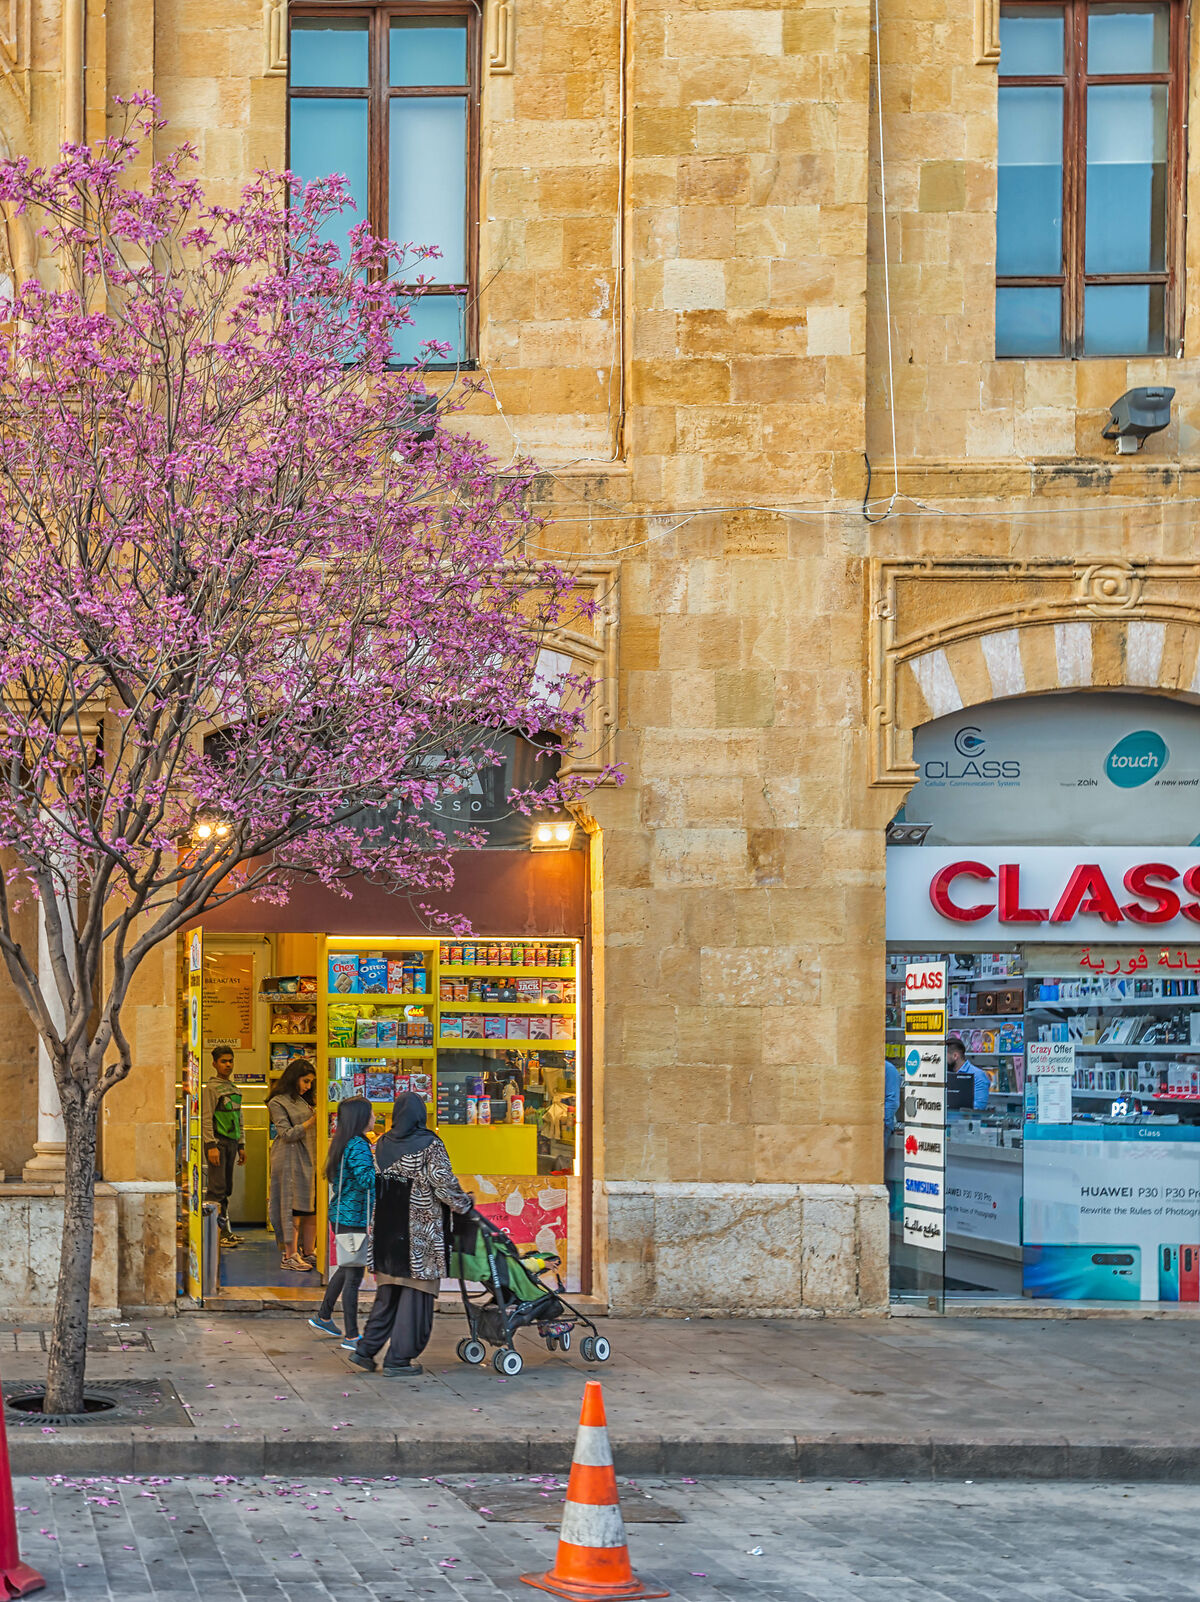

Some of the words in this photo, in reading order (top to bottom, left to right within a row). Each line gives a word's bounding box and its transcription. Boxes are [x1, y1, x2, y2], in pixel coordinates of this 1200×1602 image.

[1111, 752, 1158, 768] touch
[925, 761, 1020, 778] CLASS
[1178, 778, 1199, 787] world
[333, 963, 355, 973] Chex
[905, 971, 943, 990] CLASS
[1030, 1045, 1052, 1056] Crazy
[1054, 1045, 1073, 1053] Offer
[917, 1098, 942, 1111] iPhone
[1138, 1129, 1161, 1137] Class
[918, 1141, 942, 1153] HUAWEI
[905, 1178, 940, 1196] SAMSUNG
[1080, 1186, 1133, 1197] HUAWEI
[1138, 1187, 1158, 1198] P30
[1165, 1187, 1186, 1198] P30
[1080, 1205, 1112, 1215] Rewrite
[1114, 1206, 1128, 1215] the
[1130, 1206, 1152, 1215] Rules
[1154, 1206, 1163, 1215] of
